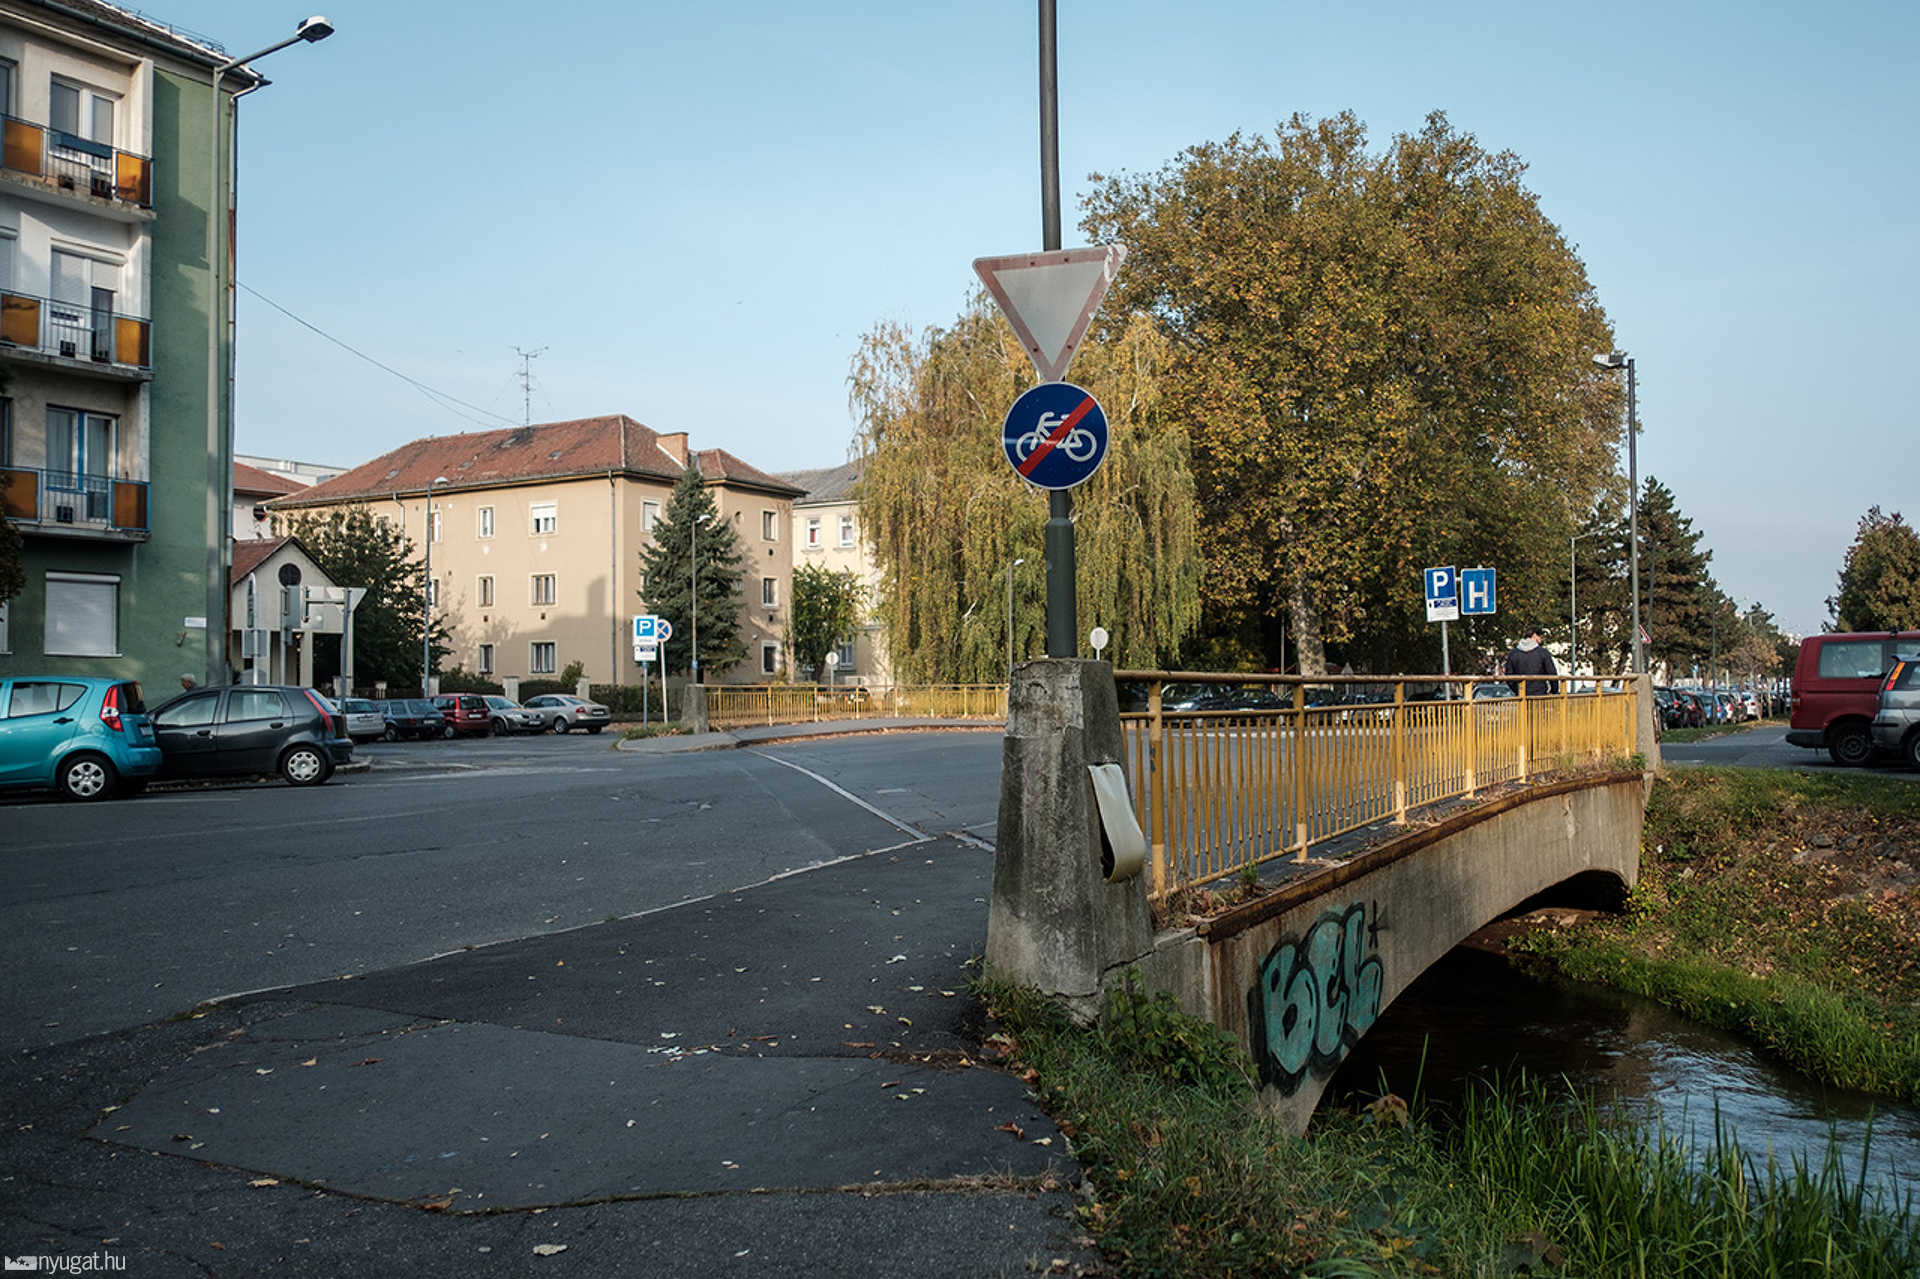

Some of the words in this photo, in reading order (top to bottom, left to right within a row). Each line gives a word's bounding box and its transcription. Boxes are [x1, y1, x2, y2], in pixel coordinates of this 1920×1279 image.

[1433, 571, 1448, 597] P
[1468, 580, 1488, 609] H
[639, 620, 652, 635] P
